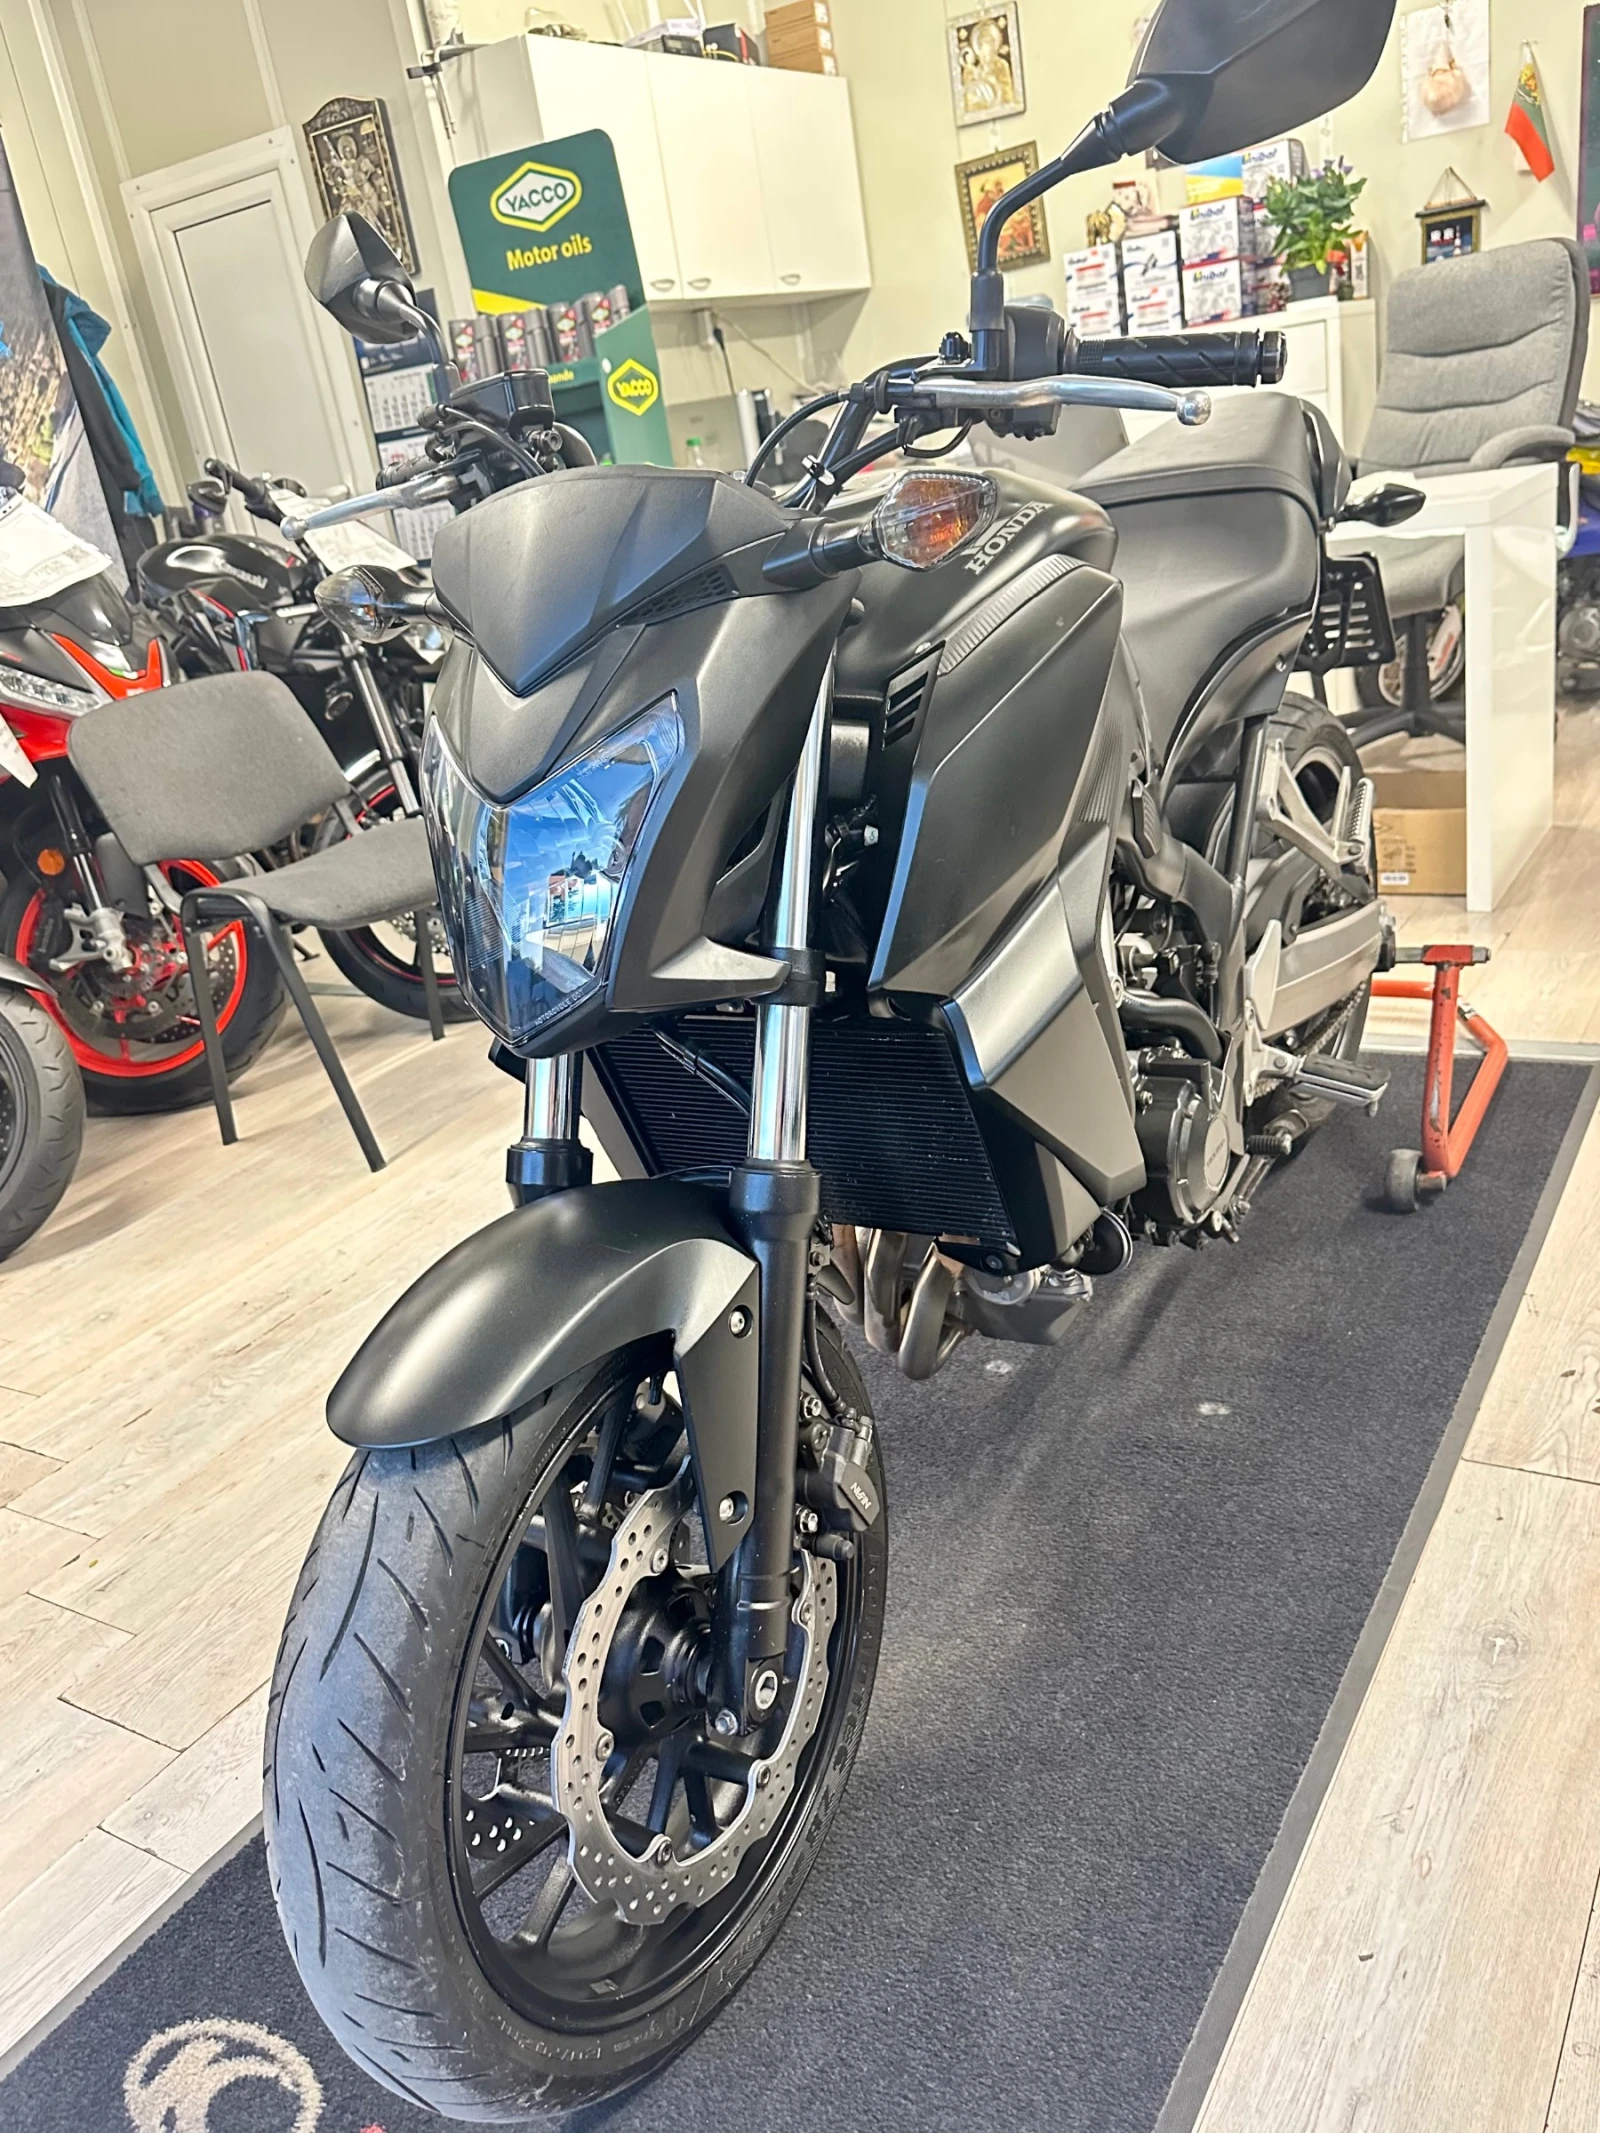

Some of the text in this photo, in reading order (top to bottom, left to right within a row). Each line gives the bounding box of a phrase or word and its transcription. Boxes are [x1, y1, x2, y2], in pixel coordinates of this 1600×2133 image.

[505, 182, 568, 213] YACCO
[1190, 204, 1226, 221] Unibat
[506, 233, 592, 272] Motor oils
[1192, 268, 1229, 283] Unibat
[616, 378, 652, 398] YACCO
[964, 500, 1054, 575] HONDA
[534, 997, 572, 1026] MOTORCYCLE
[850, 1481, 872, 1510] NISSIN
